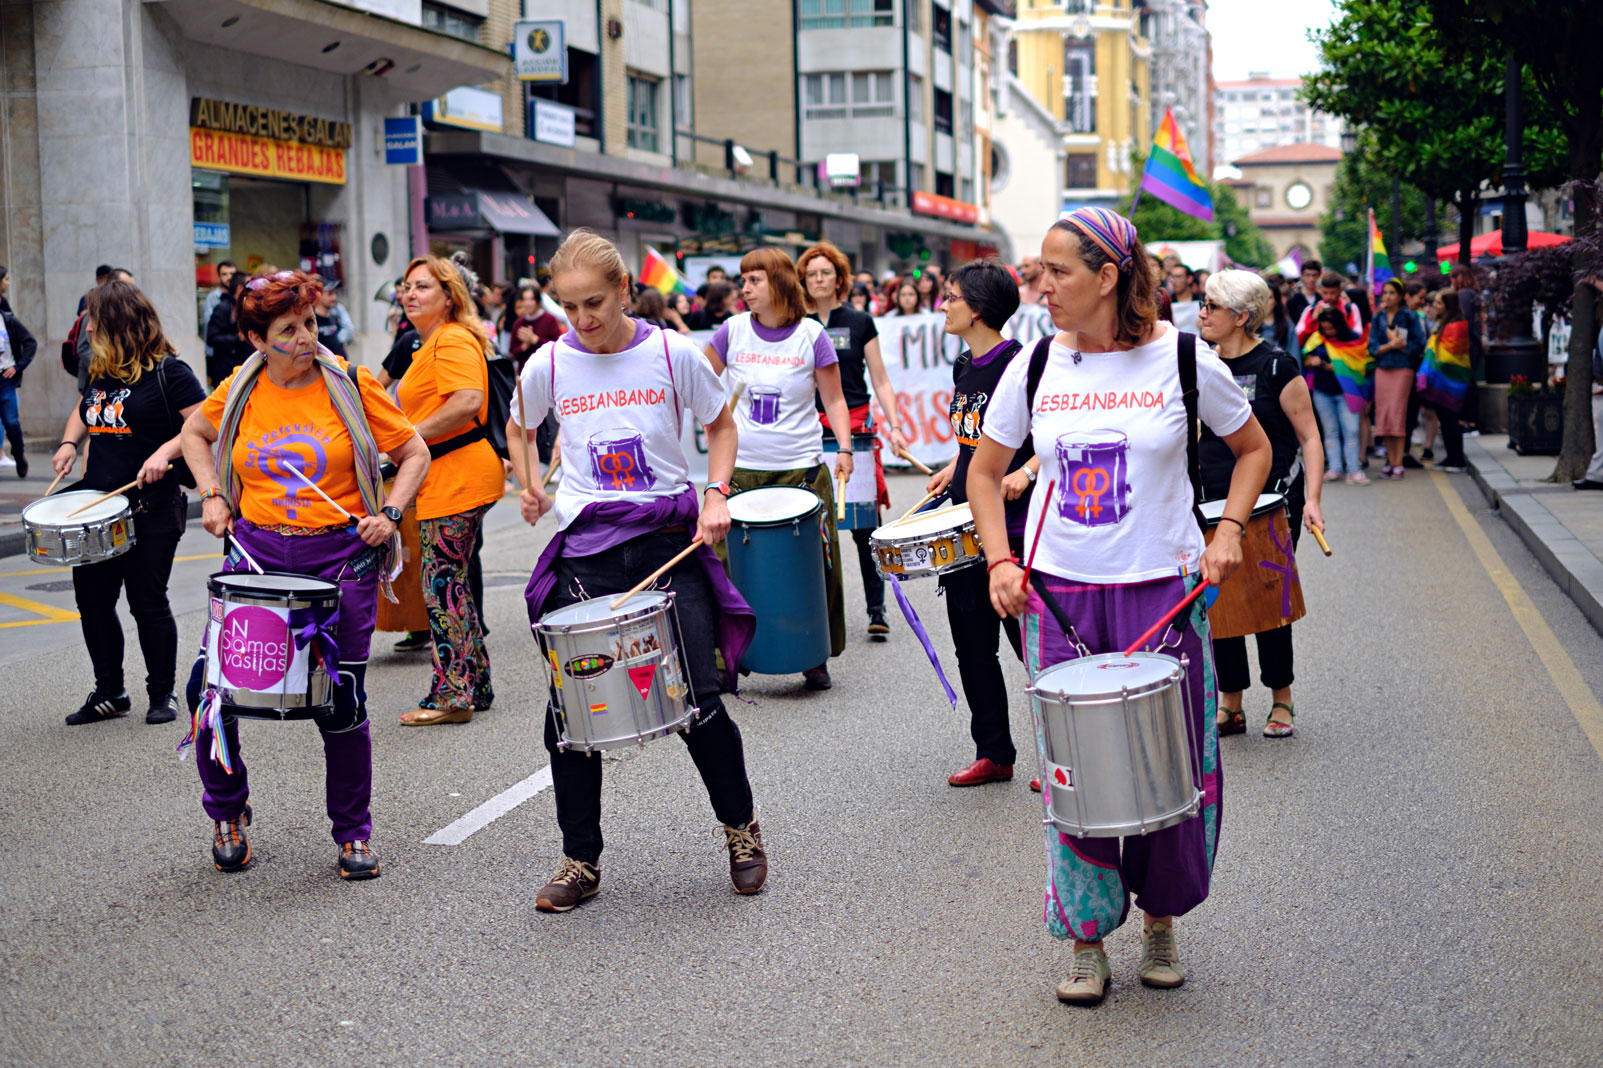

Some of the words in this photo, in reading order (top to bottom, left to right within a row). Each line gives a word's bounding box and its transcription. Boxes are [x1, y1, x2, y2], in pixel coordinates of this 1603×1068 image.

[197, 98, 300, 141] ALMACENES
[192, 131, 271, 171] GRANDES
[275, 143, 344, 179] REBAJAS
[735, 352, 806, 367] LESBIANBANDA
[559, 388, 667, 416] LESBIANBANDA
[1036, 391, 1165, 413] LESBIANBANDA
[222, 629, 288, 656] Somos
[223, 652, 287, 677] vasijas
